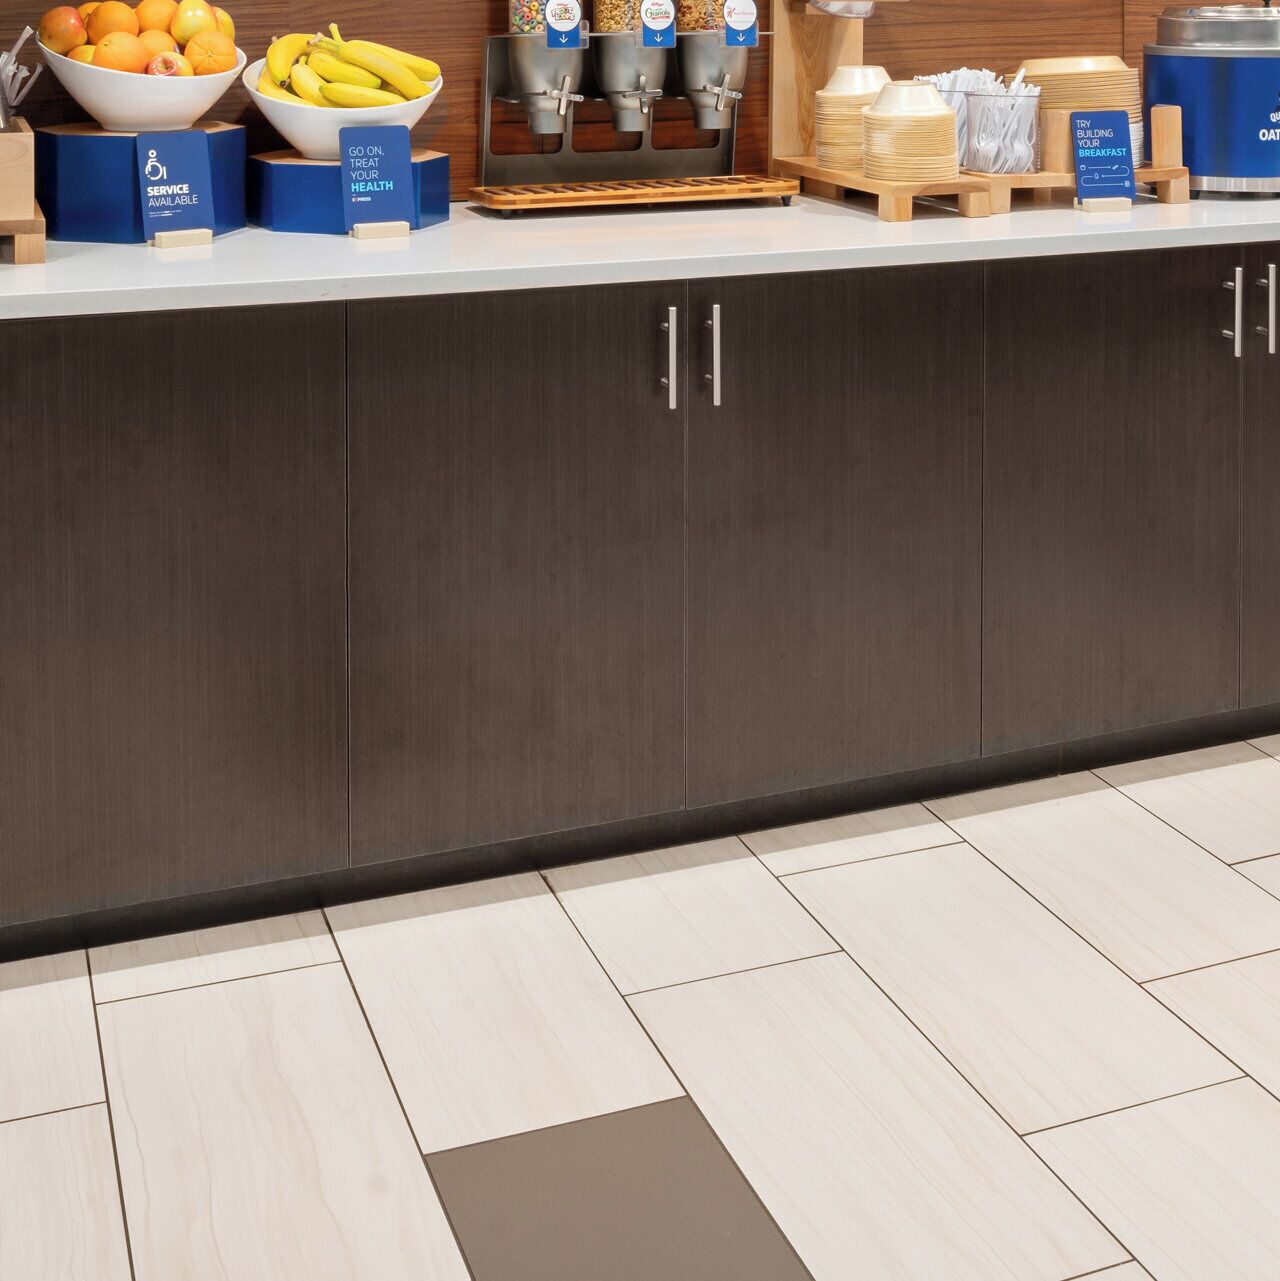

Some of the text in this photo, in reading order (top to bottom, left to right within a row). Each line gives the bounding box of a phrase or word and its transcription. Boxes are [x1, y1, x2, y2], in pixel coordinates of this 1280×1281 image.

[1076, 120, 1091, 128] TRY
[1077, 129, 1114, 138] BUILDING
[1078, 139, 1100, 147] YOUR
[349, 146, 364, 156] GO
[1079, 148, 1127, 157] BREAKFAST
[350, 158, 379, 168] TREAT
[350, 170, 379, 180] YOUR
[147, 184, 189, 196] SERVICE
[351, 181, 394, 192] HEALTH
[148, 194, 198, 207] AVAILABLE
